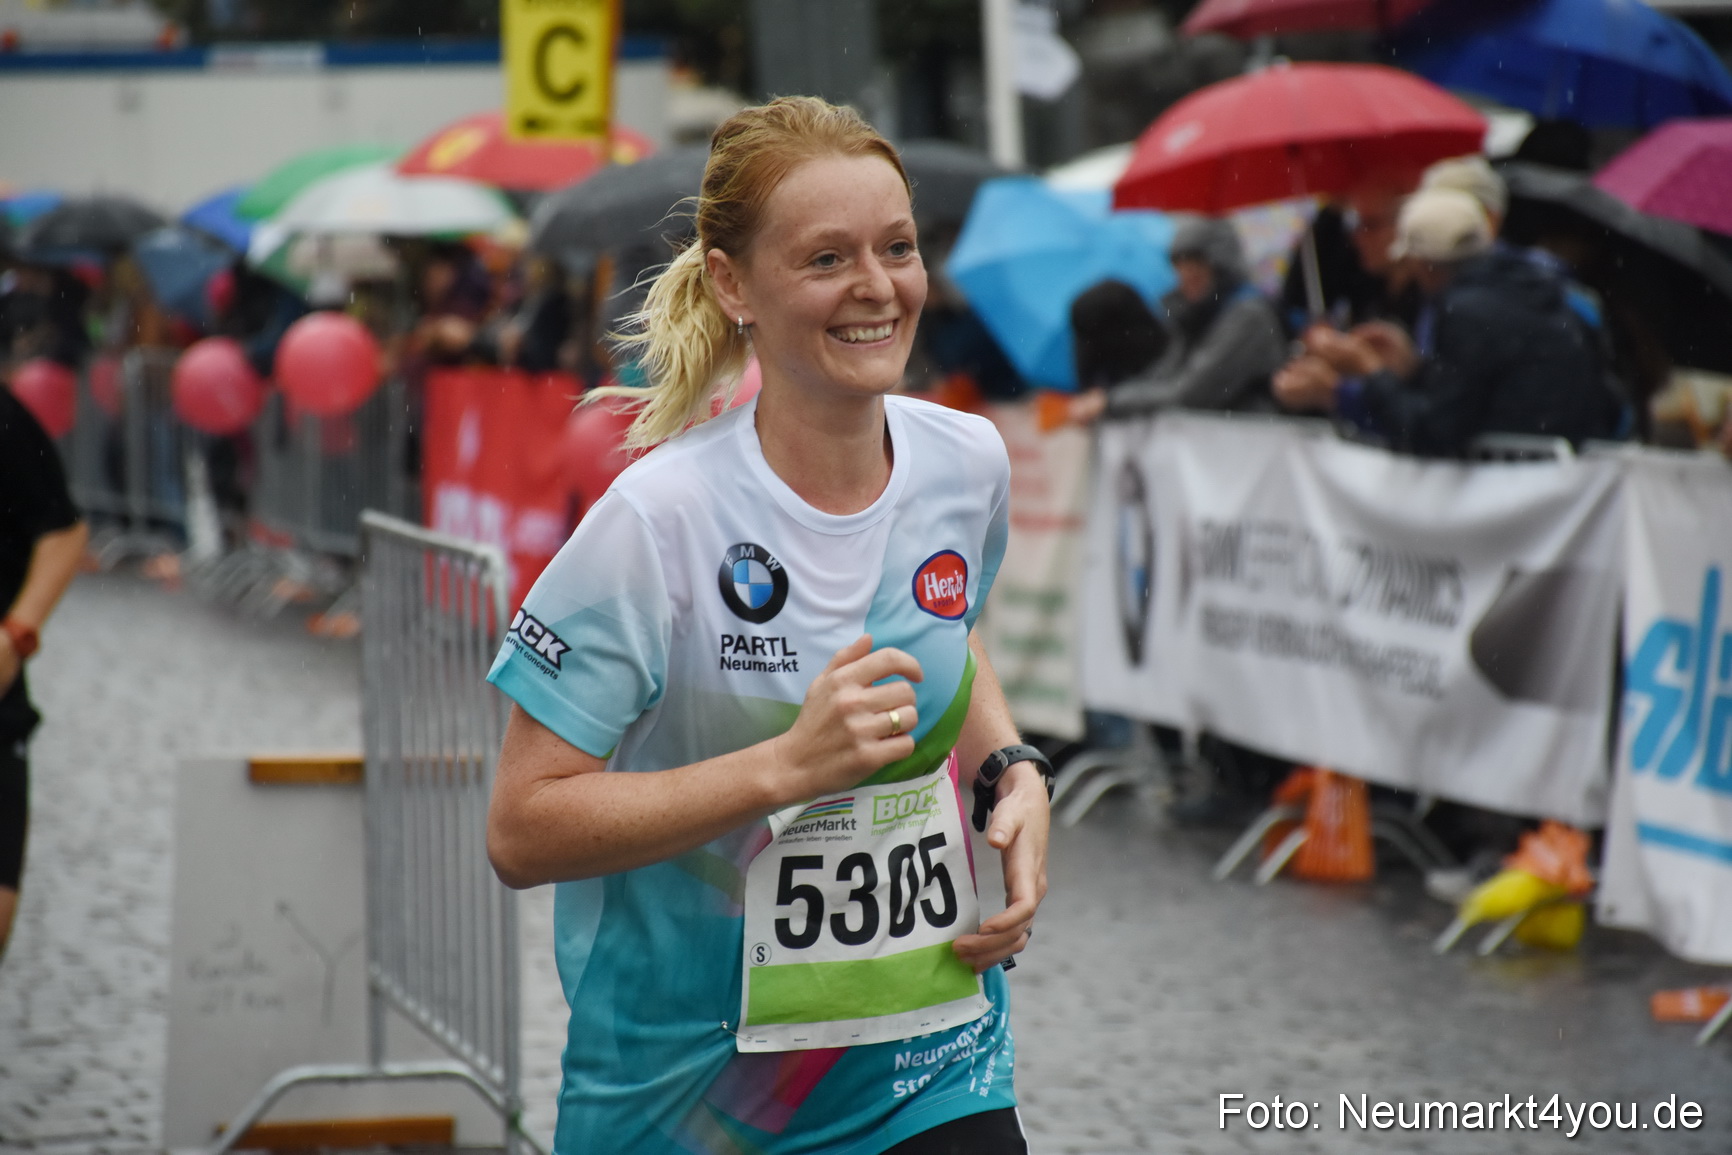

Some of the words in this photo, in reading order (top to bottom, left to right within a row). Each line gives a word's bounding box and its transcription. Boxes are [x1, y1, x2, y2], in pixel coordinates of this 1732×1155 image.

[534, 25, 586, 103] C
[724, 545, 781, 572] BMW
[923, 570, 963, 601] Hervis
[505, 636, 524, 654] smart
[523, 651, 559, 680] concepts
[720, 634, 798, 657] PARTL
[720, 655, 800, 673] Neumarkt
[824, 834, 853, 843] genießen
[775, 832, 957, 949] 5305
[756, 946, 765, 962] S
